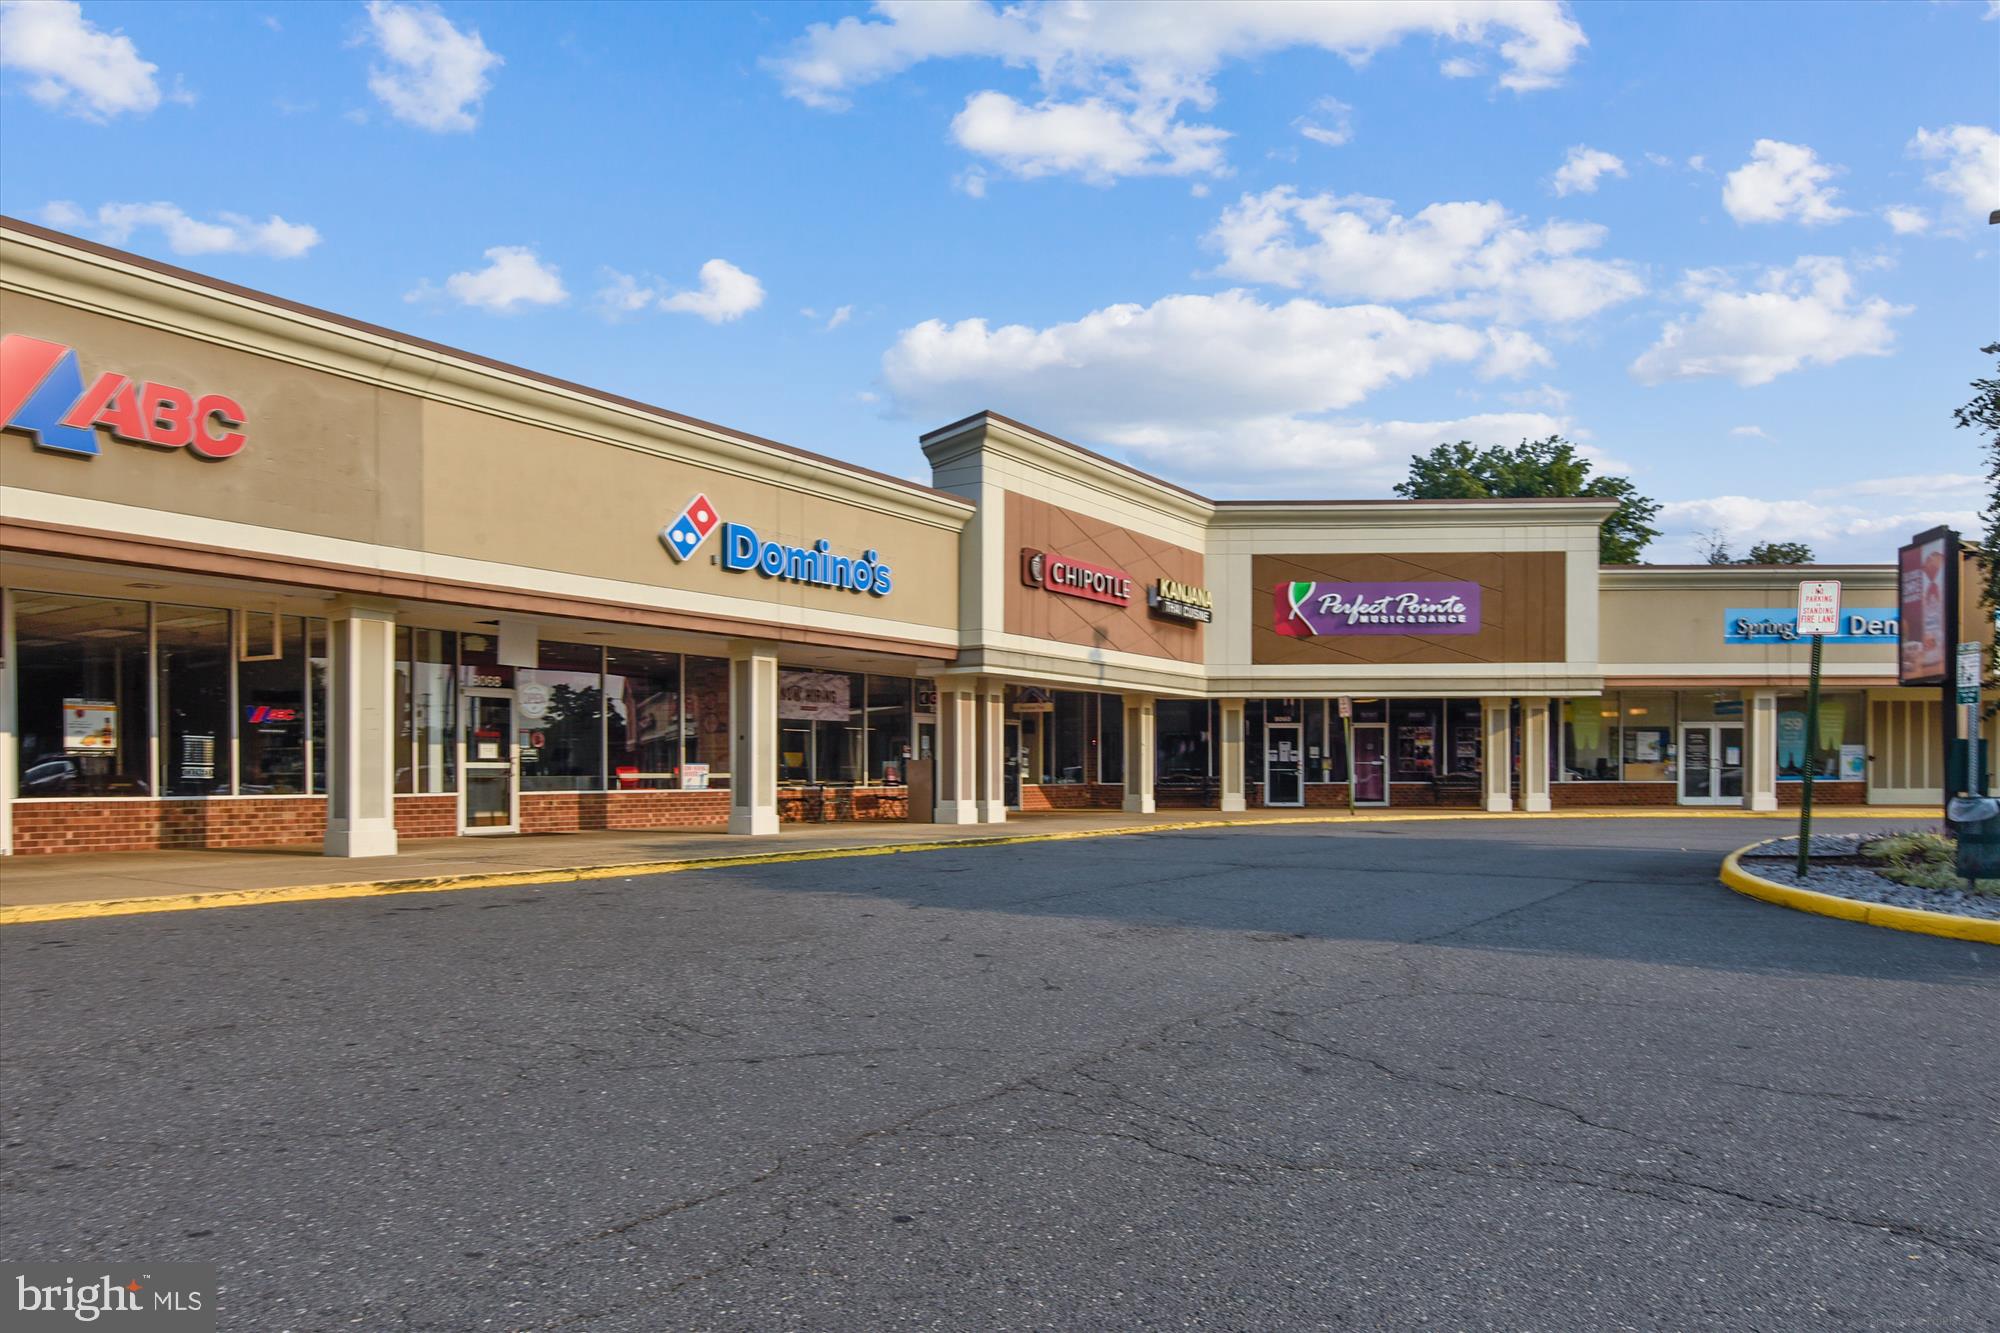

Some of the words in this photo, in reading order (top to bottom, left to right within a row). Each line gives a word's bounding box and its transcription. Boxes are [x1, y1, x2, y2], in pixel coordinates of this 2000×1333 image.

[58, 370, 248, 459] ABC
[724, 522, 892, 596] Domino's
[1052, 562, 1132, 599] CHIPOTLE
[1159, 578, 1212, 609] KANJANA
[1165, 601, 1182, 616] THAI
[1183, 605, 1211, 622] CUISINE
[1318, 593, 1388, 625] Perfect
[1391, 592, 1466, 614] Pointe
[1801, 615, 1815, 623] FIRE
[1818, 615, 1835, 623] LANE
